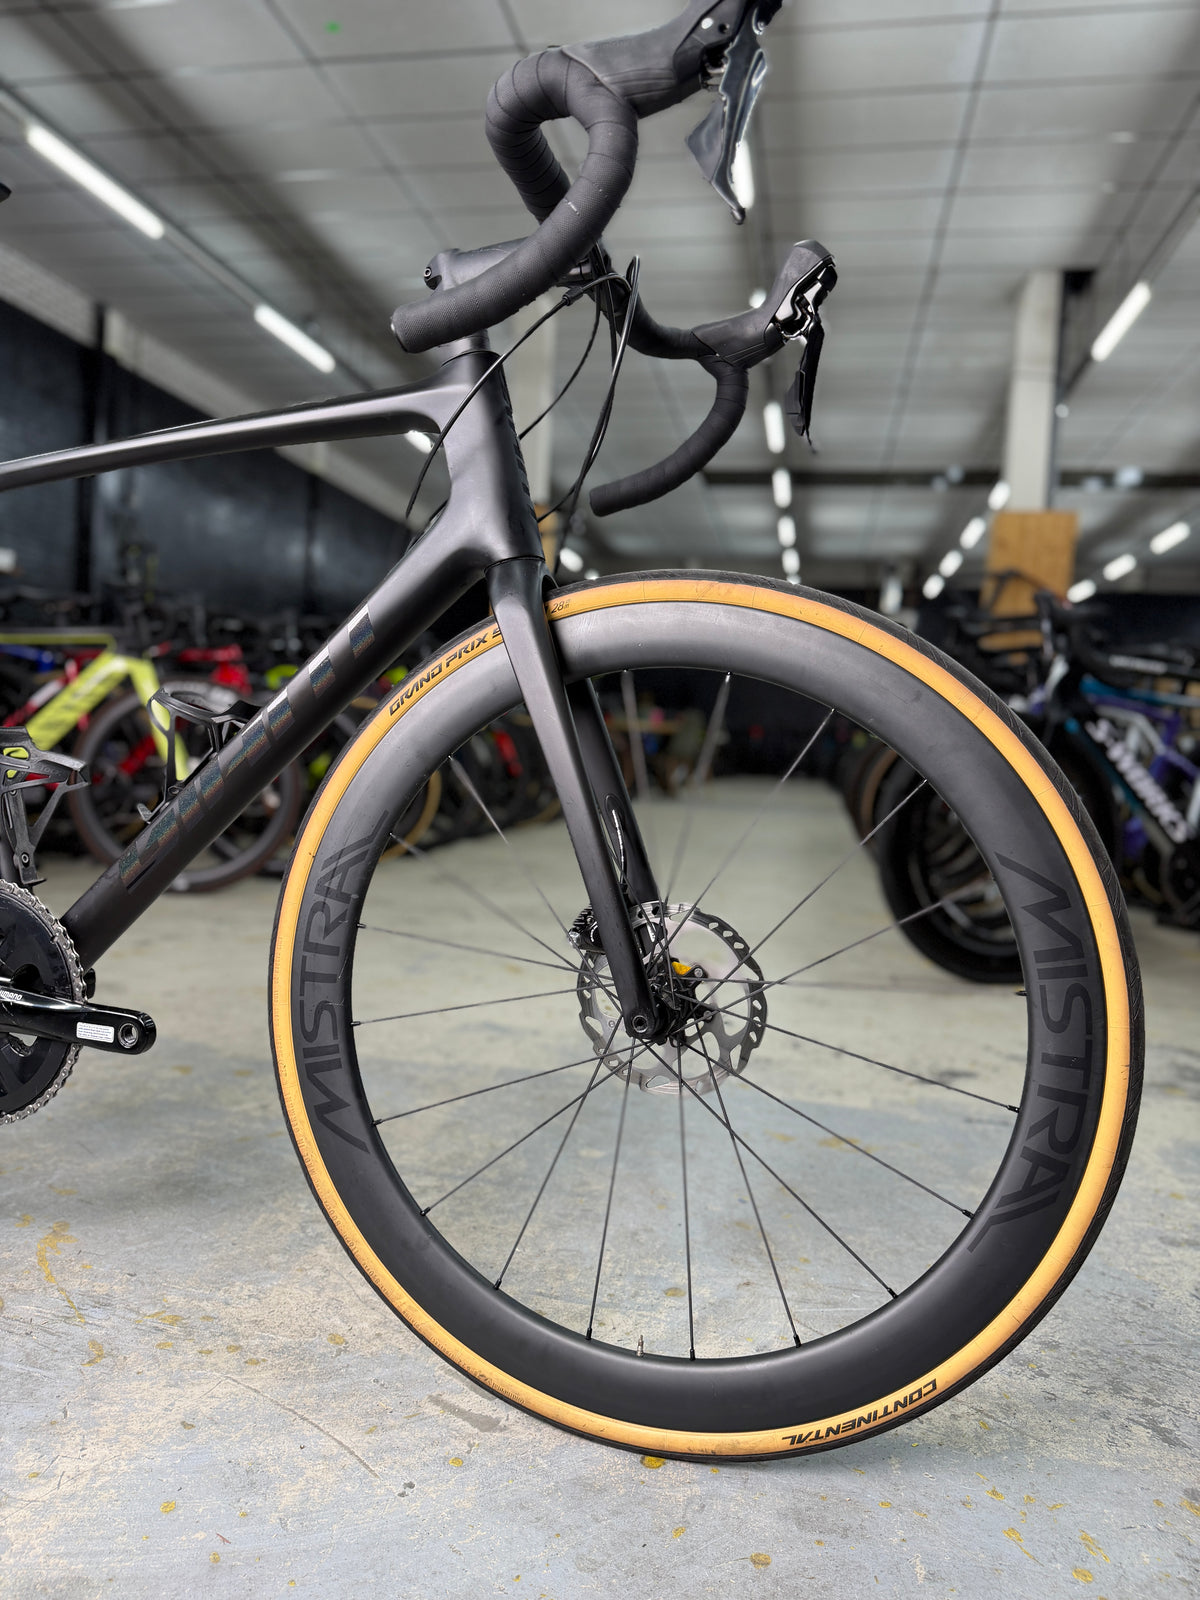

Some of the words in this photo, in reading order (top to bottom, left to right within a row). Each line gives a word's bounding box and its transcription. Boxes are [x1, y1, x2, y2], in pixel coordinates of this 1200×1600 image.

[389, 663, 443, 716] GRAND
[445, 632, 488, 668] PRIX
[300, 809, 390, 1155] MISTRAL
[967, 850, 1094, 1253] MISTRAL
[782, 1378, 938, 1446] CONTINENTAL
